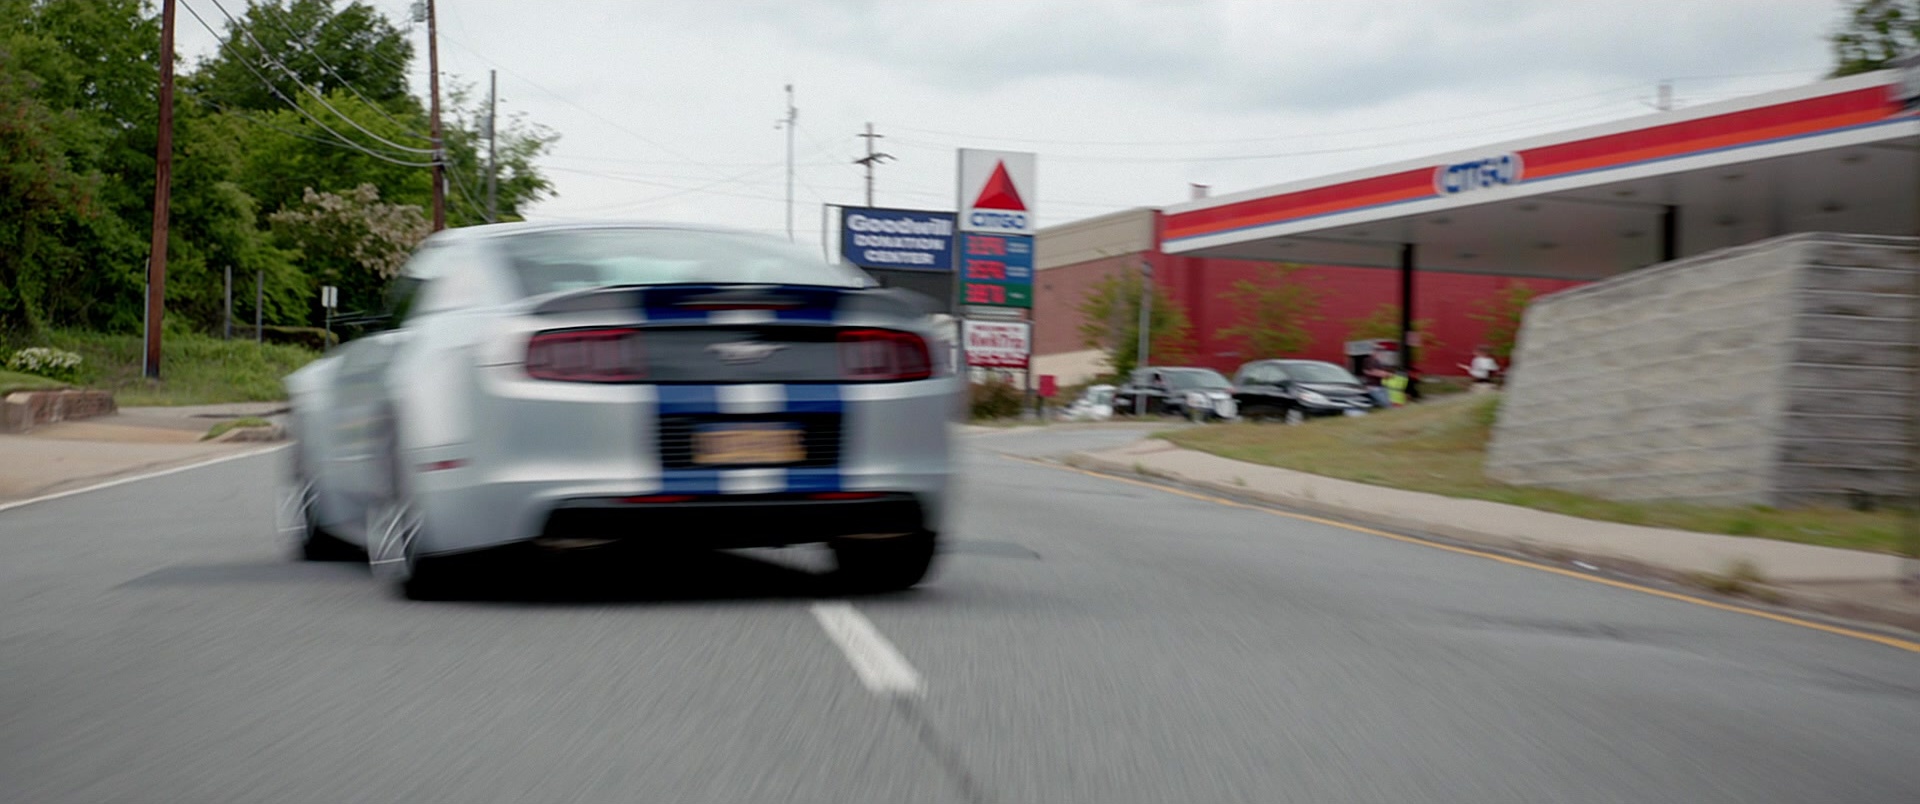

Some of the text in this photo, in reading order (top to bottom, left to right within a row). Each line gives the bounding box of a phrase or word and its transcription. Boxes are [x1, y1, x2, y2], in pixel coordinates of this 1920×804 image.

[1442, 156, 1514, 193] CITGO
[847, 213, 952, 236] Goodwill
[970, 211, 1026, 229] CITGO
[853, 233, 945, 250] DONATION
[863, 249, 935, 265] CENTER
